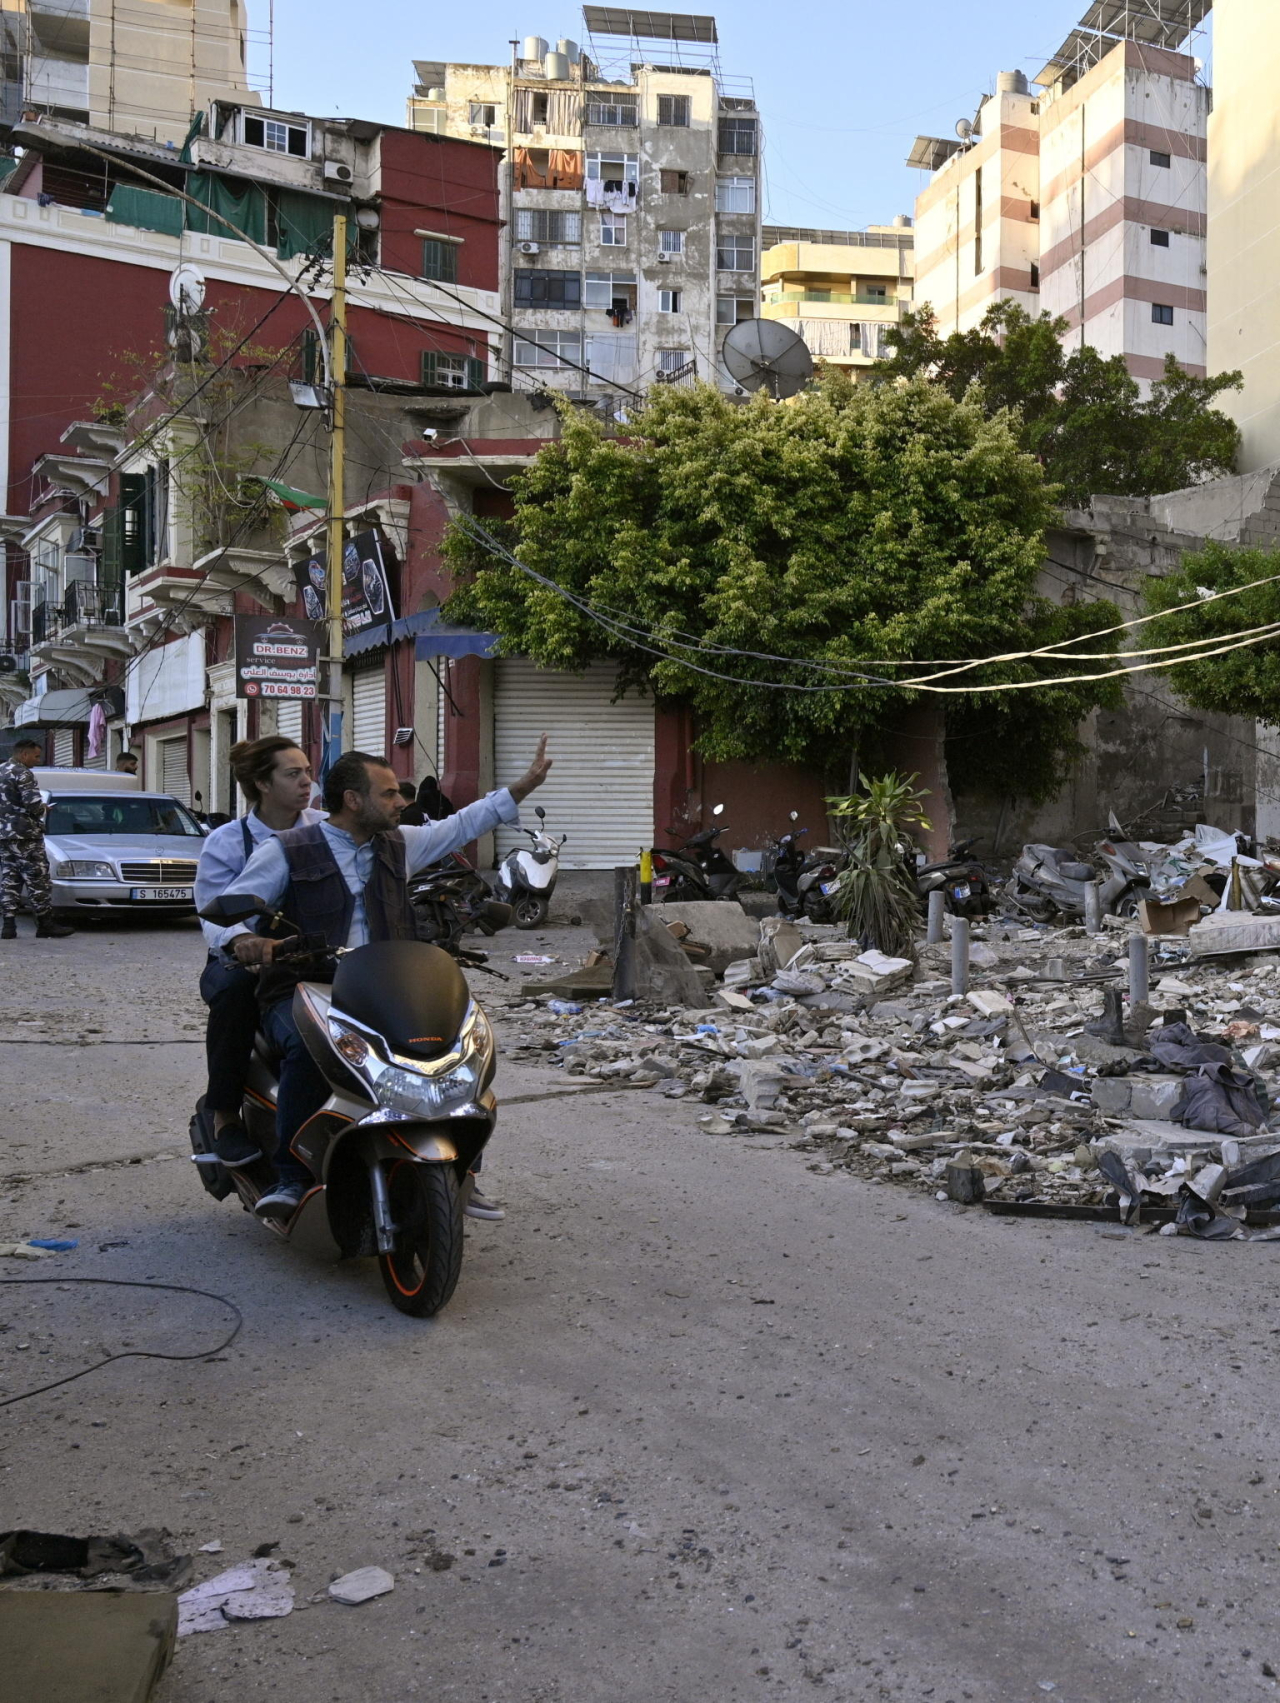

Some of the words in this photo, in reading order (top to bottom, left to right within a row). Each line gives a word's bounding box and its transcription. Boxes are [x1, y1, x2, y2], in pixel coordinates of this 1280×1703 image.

[256, 645, 306, 656] DR.BENZ
[246, 656, 276, 664] service
[269, 669, 296, 680] يوسف
[264, 684, 275, 693] 70
[277, 685, 289, 694] 64
[303, 687, 315, 696] 23
[140, 889, 147, 899] S
[153, 889, 187, 899] 165475
